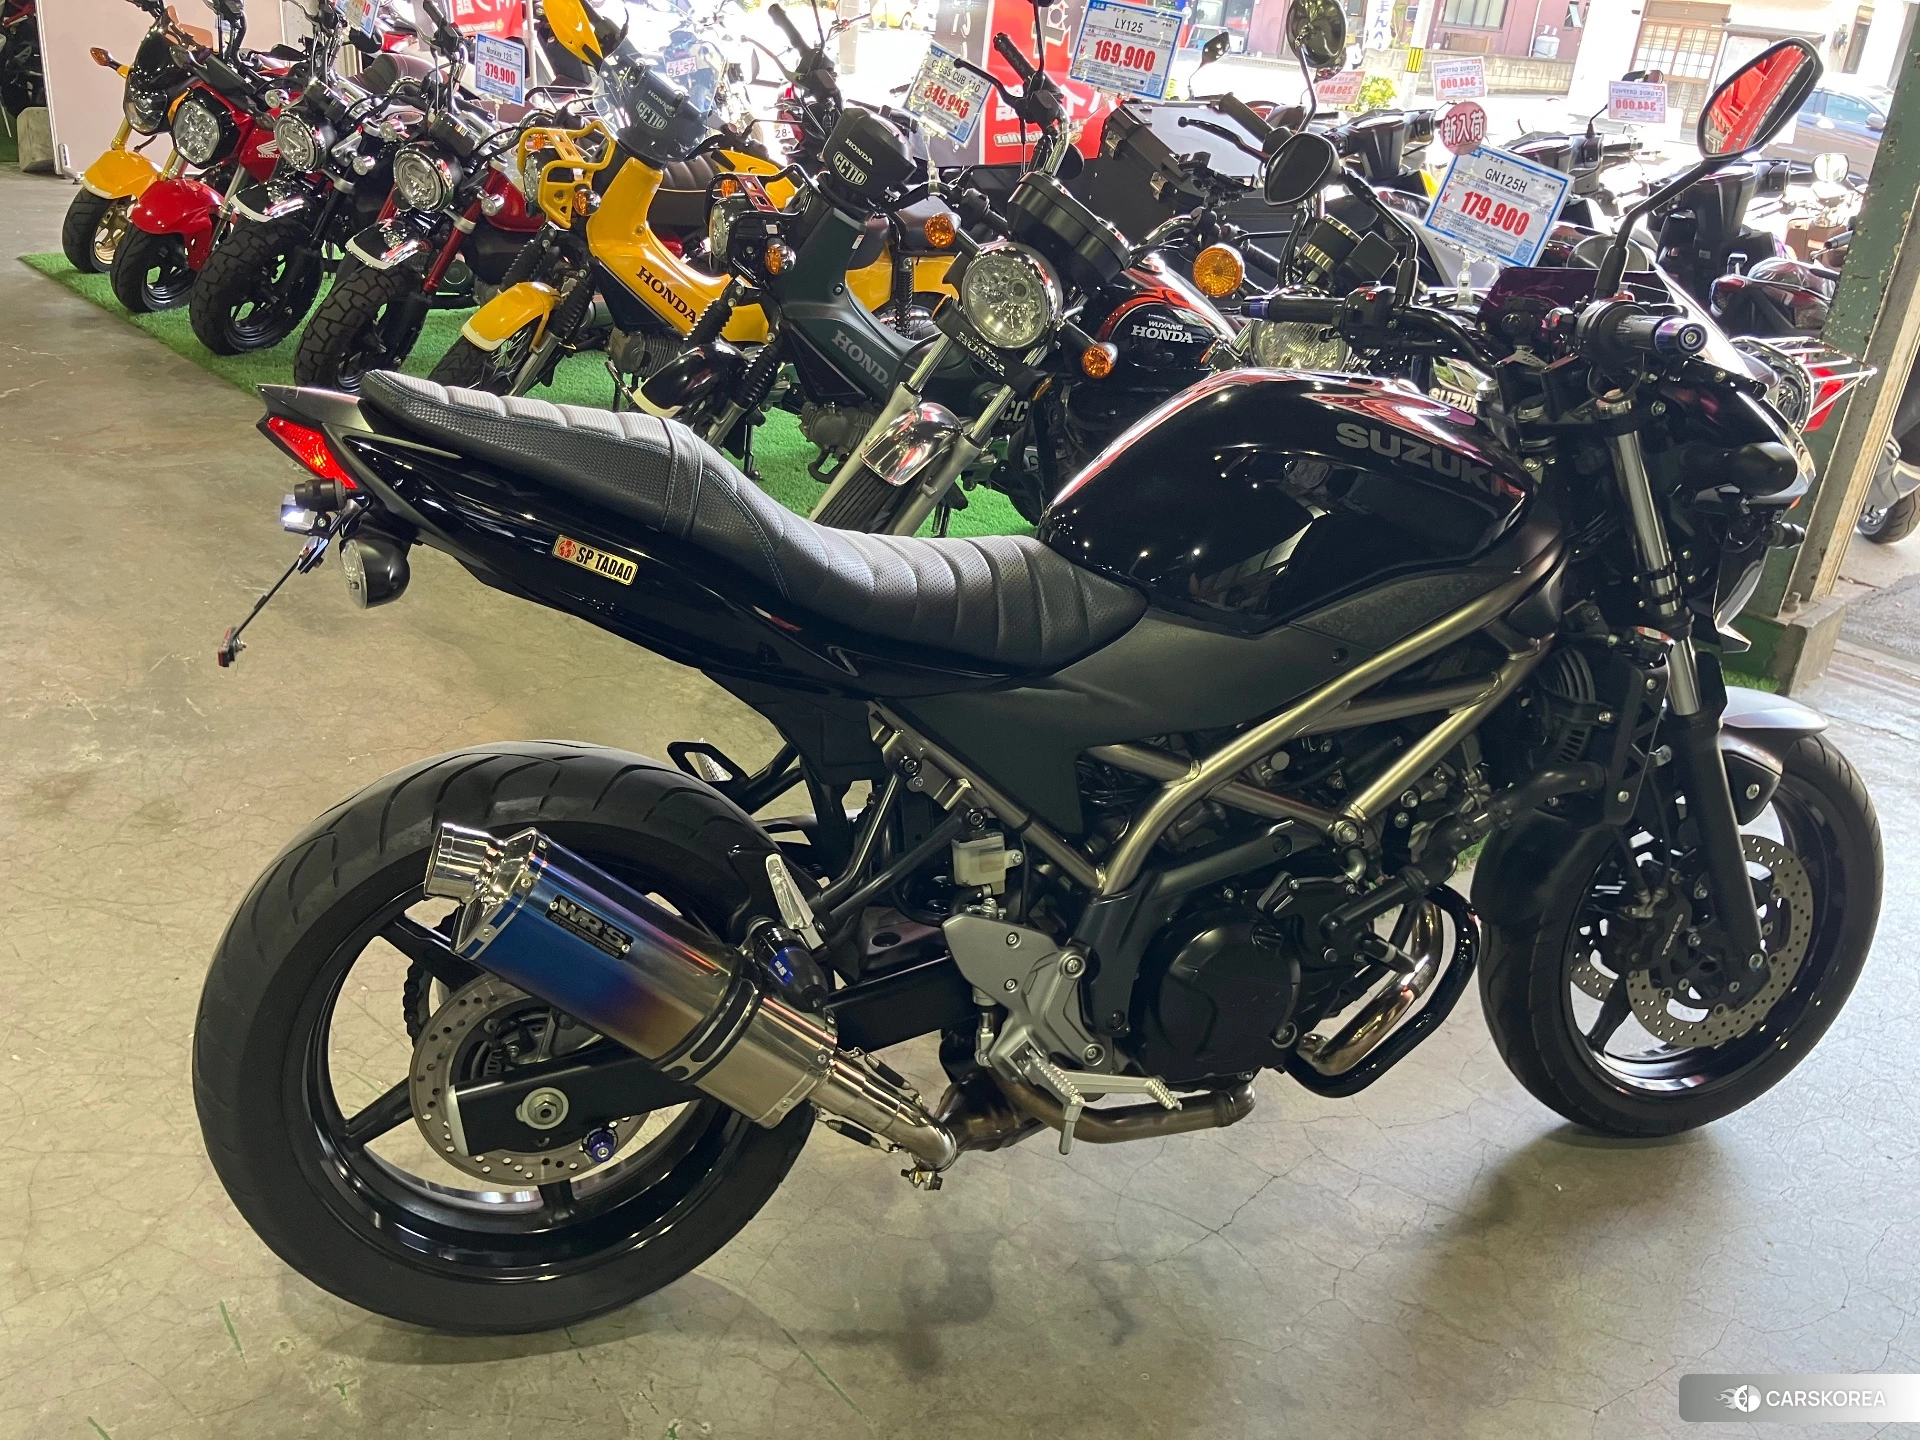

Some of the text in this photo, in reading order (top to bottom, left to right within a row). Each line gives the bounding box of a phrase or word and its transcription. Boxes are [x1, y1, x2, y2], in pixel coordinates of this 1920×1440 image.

[1114, 18, 1144, 34] LY125
[486, 46, 512, 62] Monkey 125
[1094, 40, 1156, 72] 169,900
[485, 62, 516, 86] 379,900
[668, 64, 695, 76] 96-52
[932, 60, 951, 76] COSS
[952, 72, 966, 84] CUB
[638, 102, 666, 129] CC110
[1443, 110, 1484, 146] 新入荷
[845, 138, 873, 166] HONDA
[834, 153, 865, 184] CC110
[1485, 168, 1528, 194] GN125H
[1442, 190, 1530, 236] ¥ 179,900
[636, 266, 696, 324] HONDA
[1131, 324, 1194, 344] HONDA
[1148, 320, 1184, 330] WUYANG
[956, 331, 1005, 376] HONDA
[1429, 388, 1478, 414] SUZUK
[1336, 422, 1499, 496] SUZUKI
[576, 546, 634, 581] SP TADAO
[558, 897, 627, 948] WR'S
